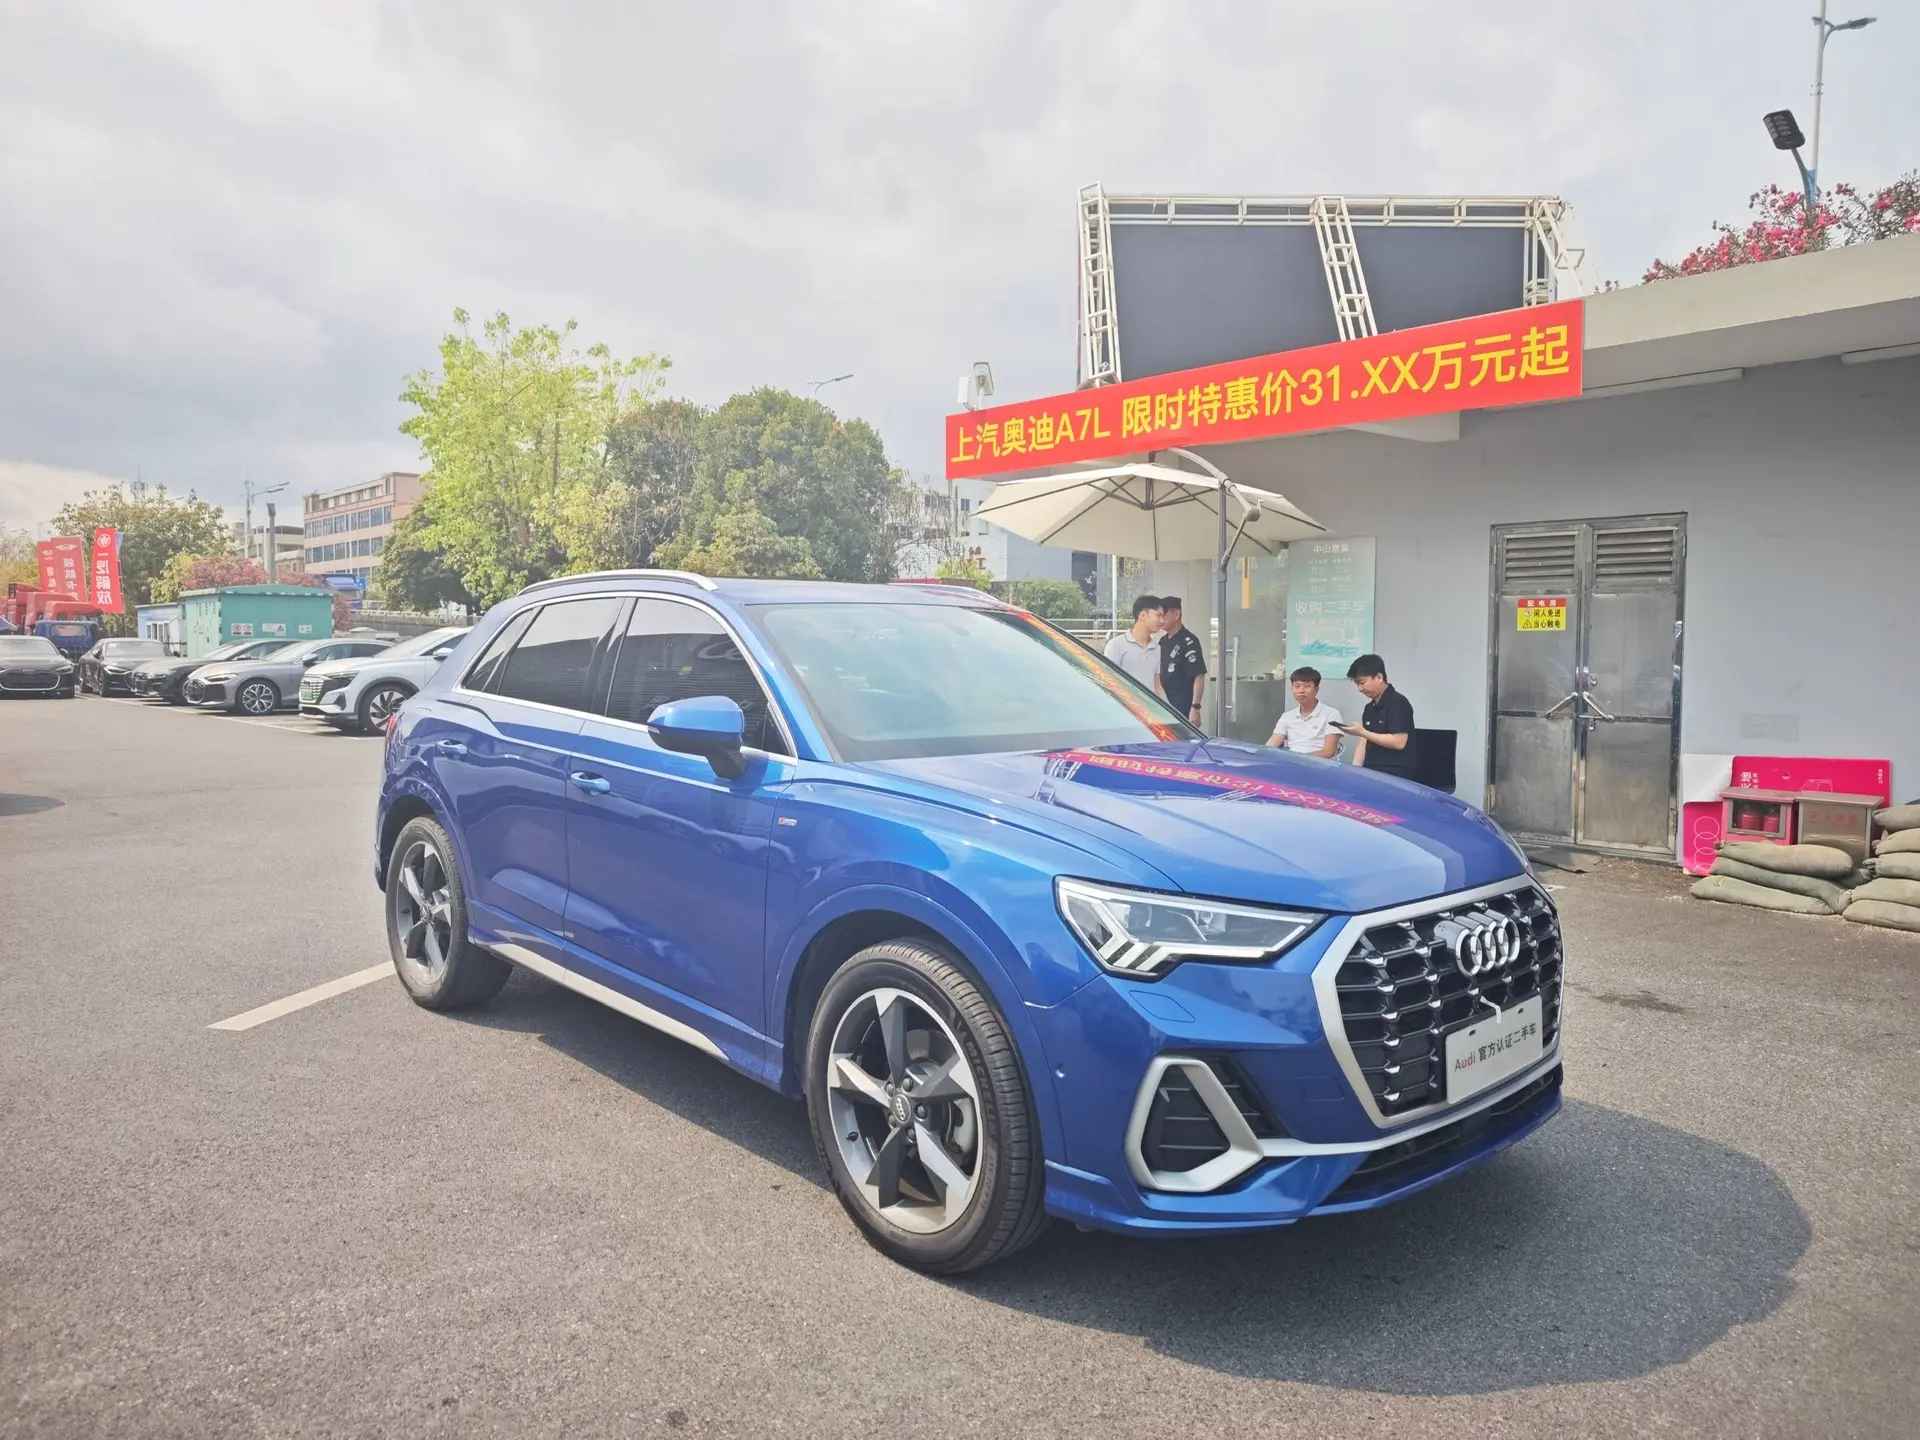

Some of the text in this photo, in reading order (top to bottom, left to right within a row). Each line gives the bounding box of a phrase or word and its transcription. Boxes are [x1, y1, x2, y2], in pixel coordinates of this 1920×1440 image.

[951, 325, 1570, 463] 上汽奥迪A7L 限时特惠价31.XX万元起
[1295, 600, 1366, 615] 收购二手车
[1533, 609, 1561, 618] 闲人免进
[1533, 619, 1561, 629] 当心触电
[1454, 1022, 1537, 1073] Audi 官方认证二手车
